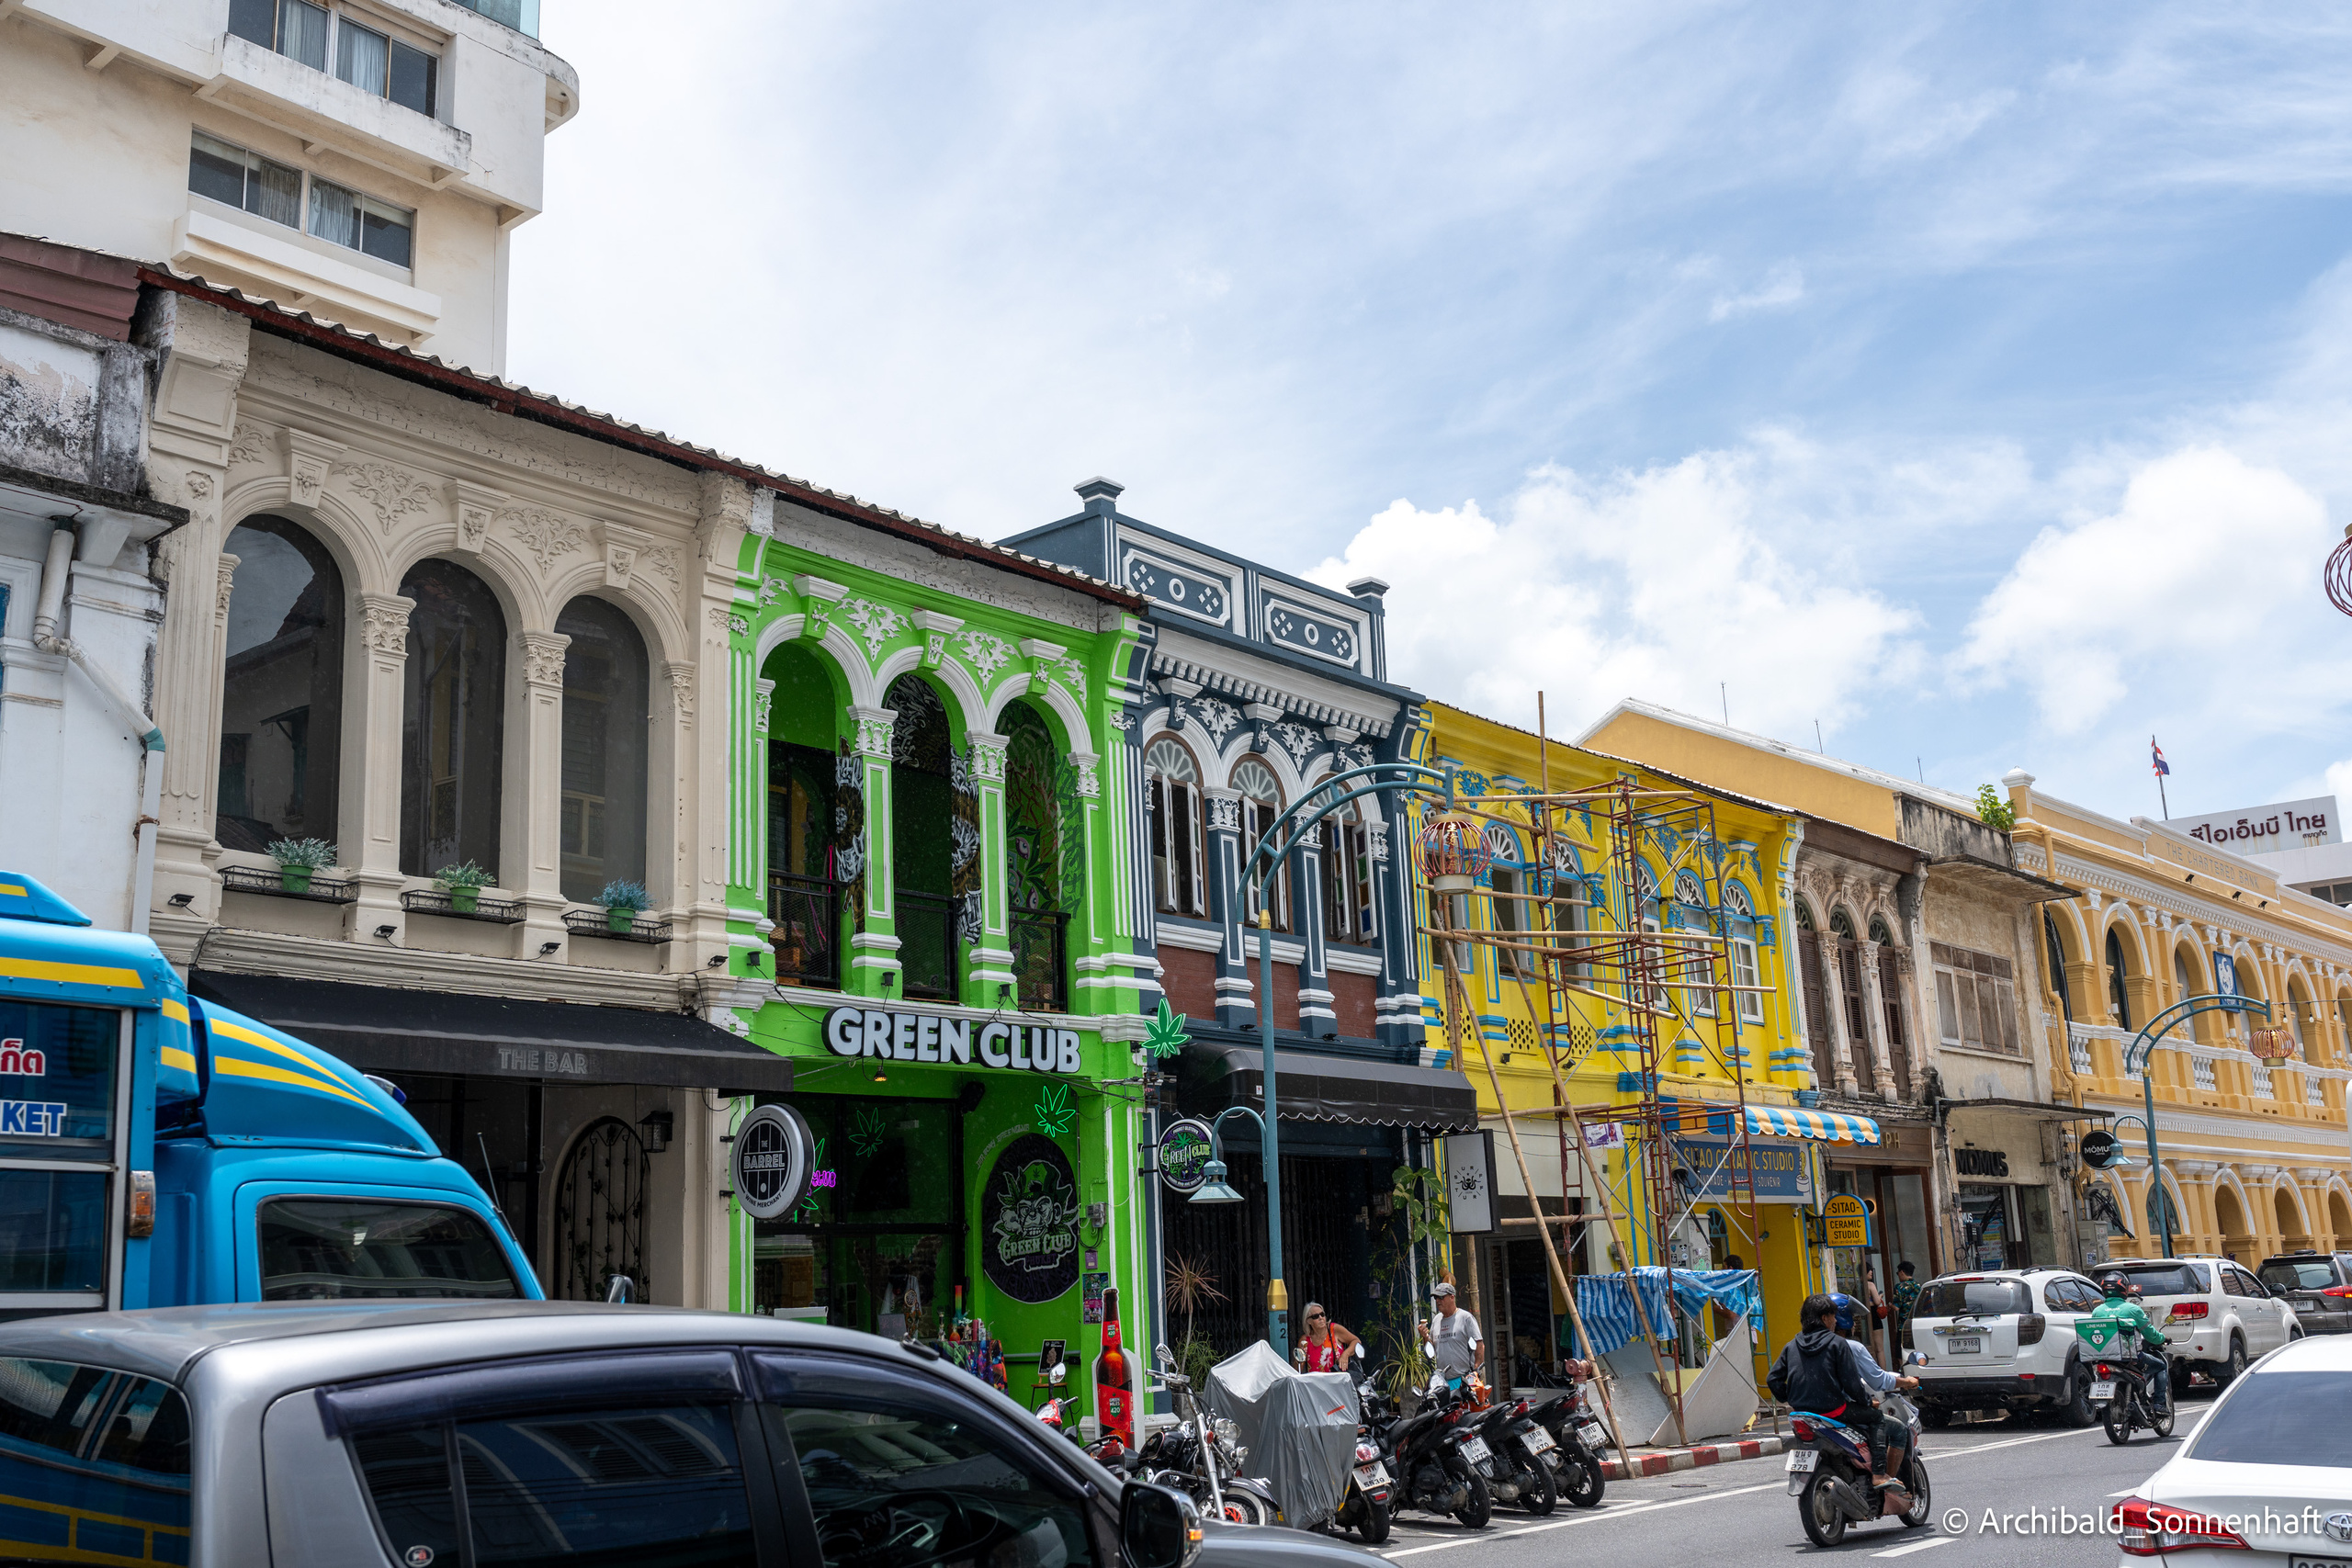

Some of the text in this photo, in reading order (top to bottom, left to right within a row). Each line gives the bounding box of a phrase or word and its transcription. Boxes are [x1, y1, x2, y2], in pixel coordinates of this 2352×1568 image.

[2284, 811, 2326, 832] ไทย
[2166, 842, 2259, 889] THE CHARTERED BANK
[826, 1006, 1081, 1074] GREEN CLUB
[499, 1047, 539, 1071] THE
[1192, 1144, 1210, 1157] CLUB
[1683, 1146, 1713, 1168] SITAO
[1761, 1151, 1794, 1171] STUDIO
[743, 1154, 786, 1169] BARREL
[1758, 1177, 1781, 1188] SOUVENIR
[745, 1192, 782, 1208] WINE MERCHANT
[1829, 1220, 1861, 1229] CERAMIC
[1833, 1230, 1860, 1239] STUDIO
[1001, 1233, 1072, 1260] GREEN CLUB
